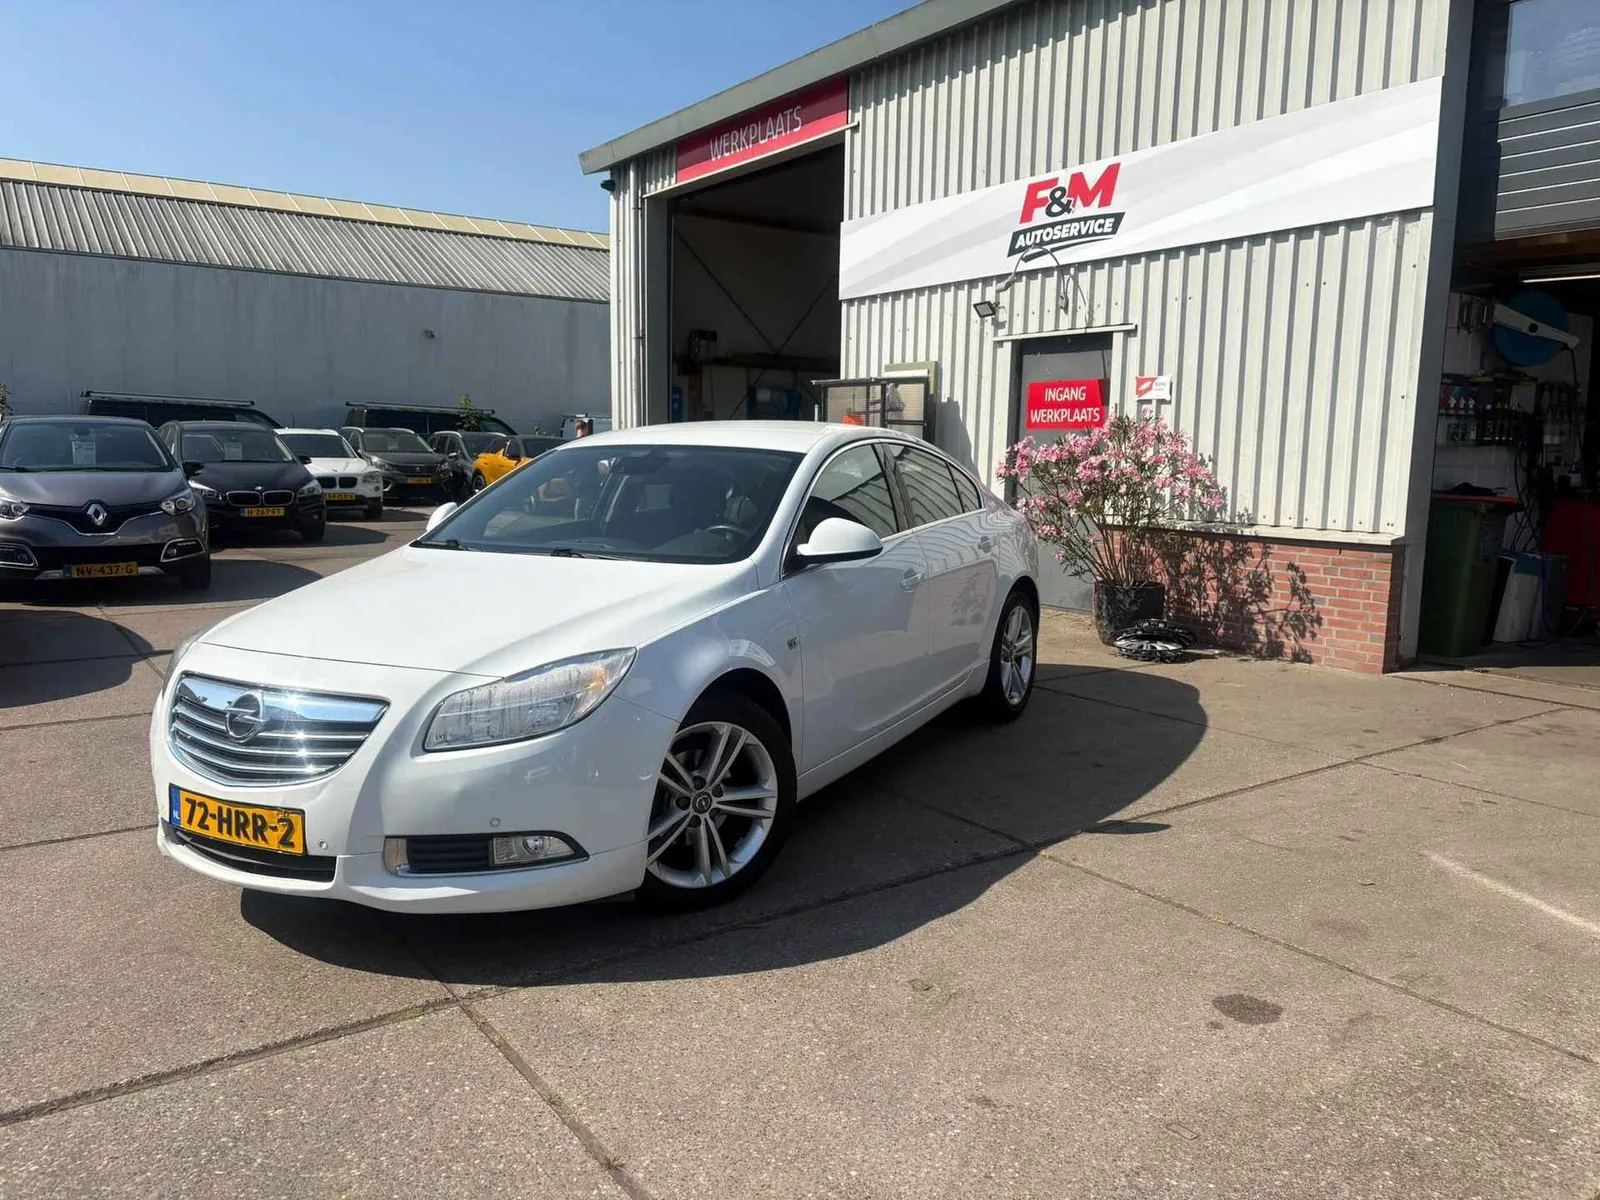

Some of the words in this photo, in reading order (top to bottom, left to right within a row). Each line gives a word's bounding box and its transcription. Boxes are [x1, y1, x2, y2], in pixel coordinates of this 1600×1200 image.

[709, 105, 803, 162] WERKPLAATS
[1019, 161, 1122, 225] F&M
[1014, 217, 1116, 250] AUTOSERVICE
[1044, 386, 1087, 402] INGANG
[1030, 407, 1100, 423] WERKPLAATS
[76, 564, 134, 576] NV-437-G
[184, 797, 295, 849] 72-HRR-2
